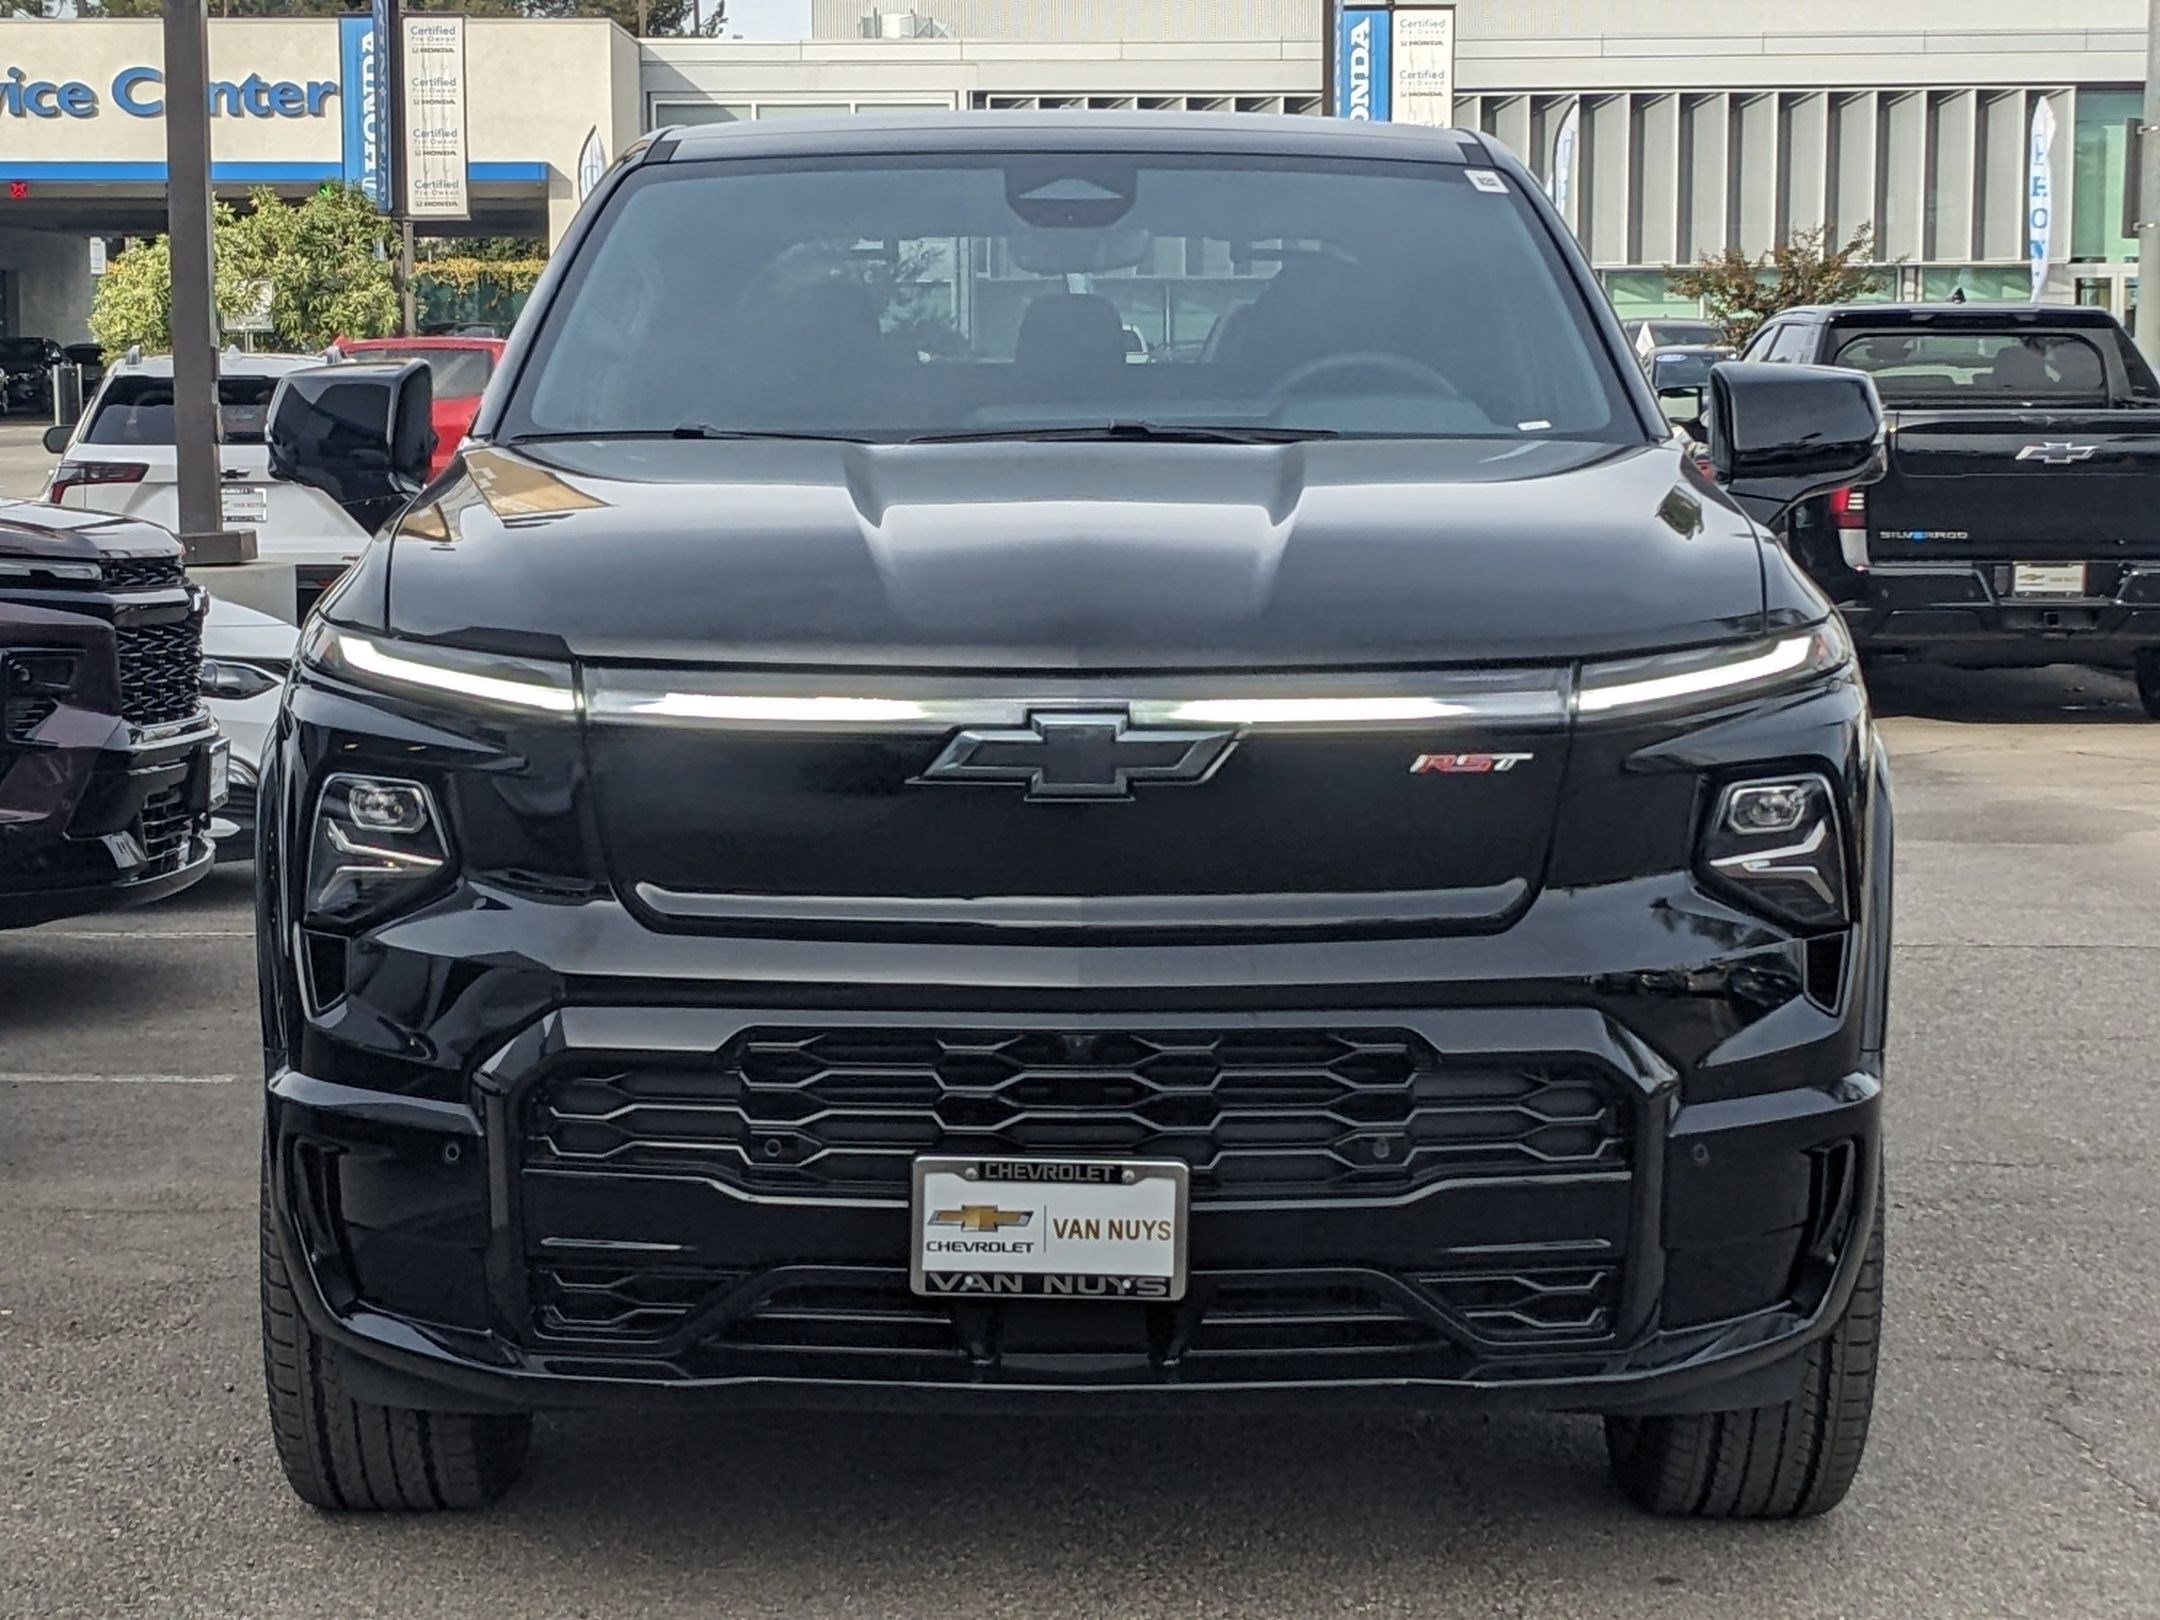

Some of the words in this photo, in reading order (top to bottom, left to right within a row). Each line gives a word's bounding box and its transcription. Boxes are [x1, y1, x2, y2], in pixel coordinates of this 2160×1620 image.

[411, 26, 456, 36] Certified
[1400, 19, 1446, 29] Certified
[1350, 16, 1370, 121] ONDA
[1400, 70, 1445, 80] Certified
[412, 77, 457, 87] Certified
[111, 66, 338, 118] Cnter
[362, 31, 377, 173] HONDA
[413, 128, 458, 138] Certified
[414, 180, 459, 190] Certified
[1410, 752, 1534, 773] RST
[985, 1162, 1116, 1182] CHEVROLET
[1053, 1218, 1100, 1240] VAN
[1108, 1219, 1172, 1241] NUYS
[926, 1240, 1035, 1253] CHEVROLET
[928, 1272, 1023, 1293] VAN
[1043, 1274, 1168, 1296] NUYS
